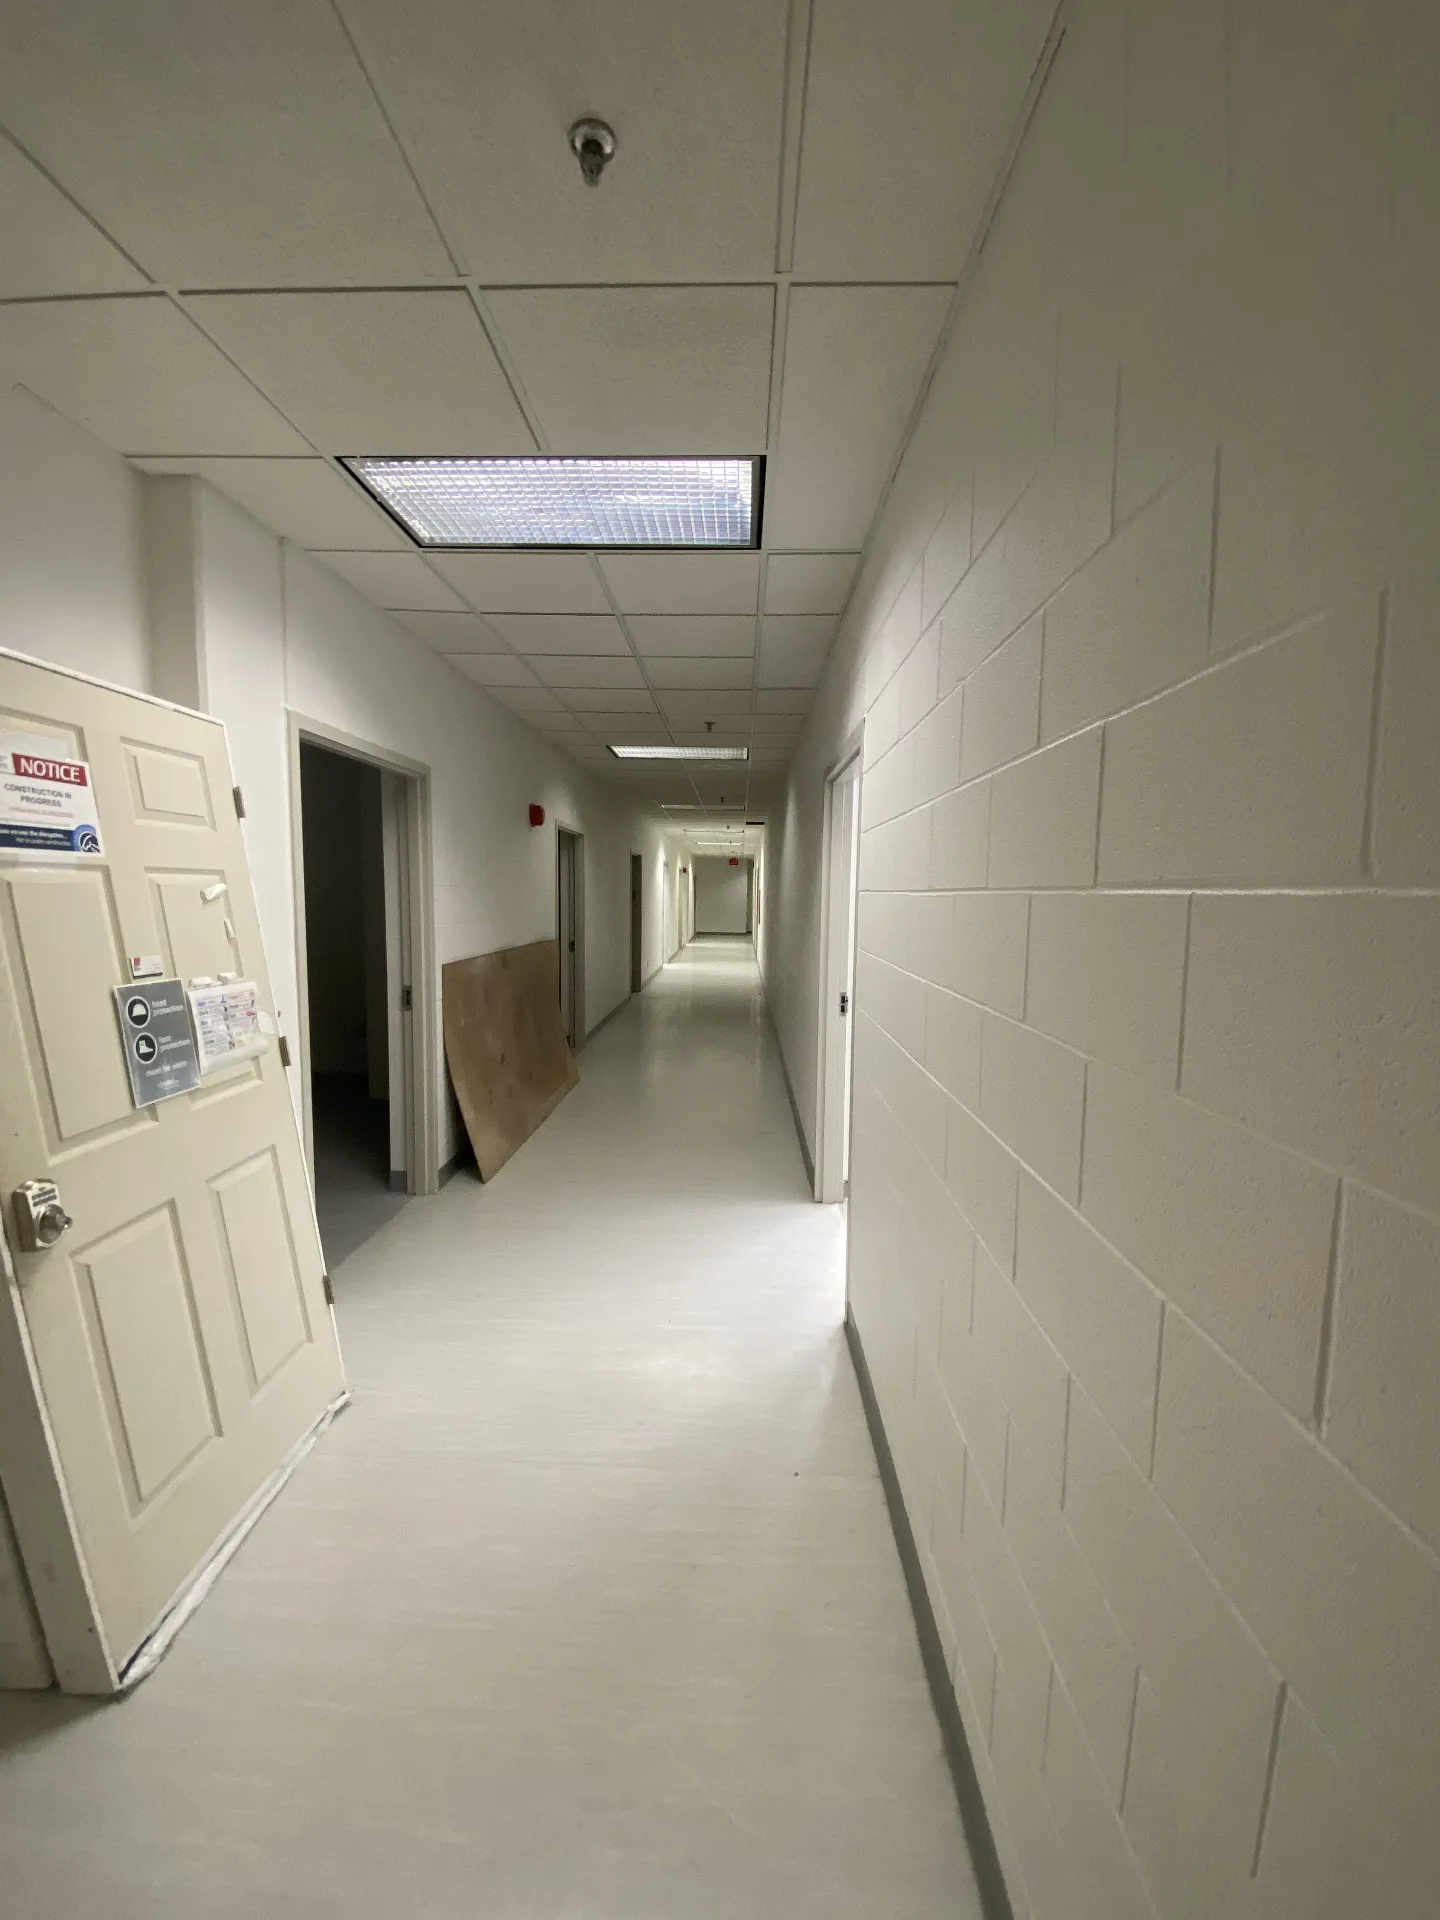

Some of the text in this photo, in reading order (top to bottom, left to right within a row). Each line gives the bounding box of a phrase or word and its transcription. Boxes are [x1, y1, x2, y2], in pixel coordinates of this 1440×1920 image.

[20, 758, 81, 783] NOTICE
[4, 783, 63, 798] CONSTRUCTION
[20, 795, 62, 808] PROGRESS
[151, 999, 167, 1008] head
[153, 1004, 184, 1017] protection
[160, 1039, 191, 1052] protection
